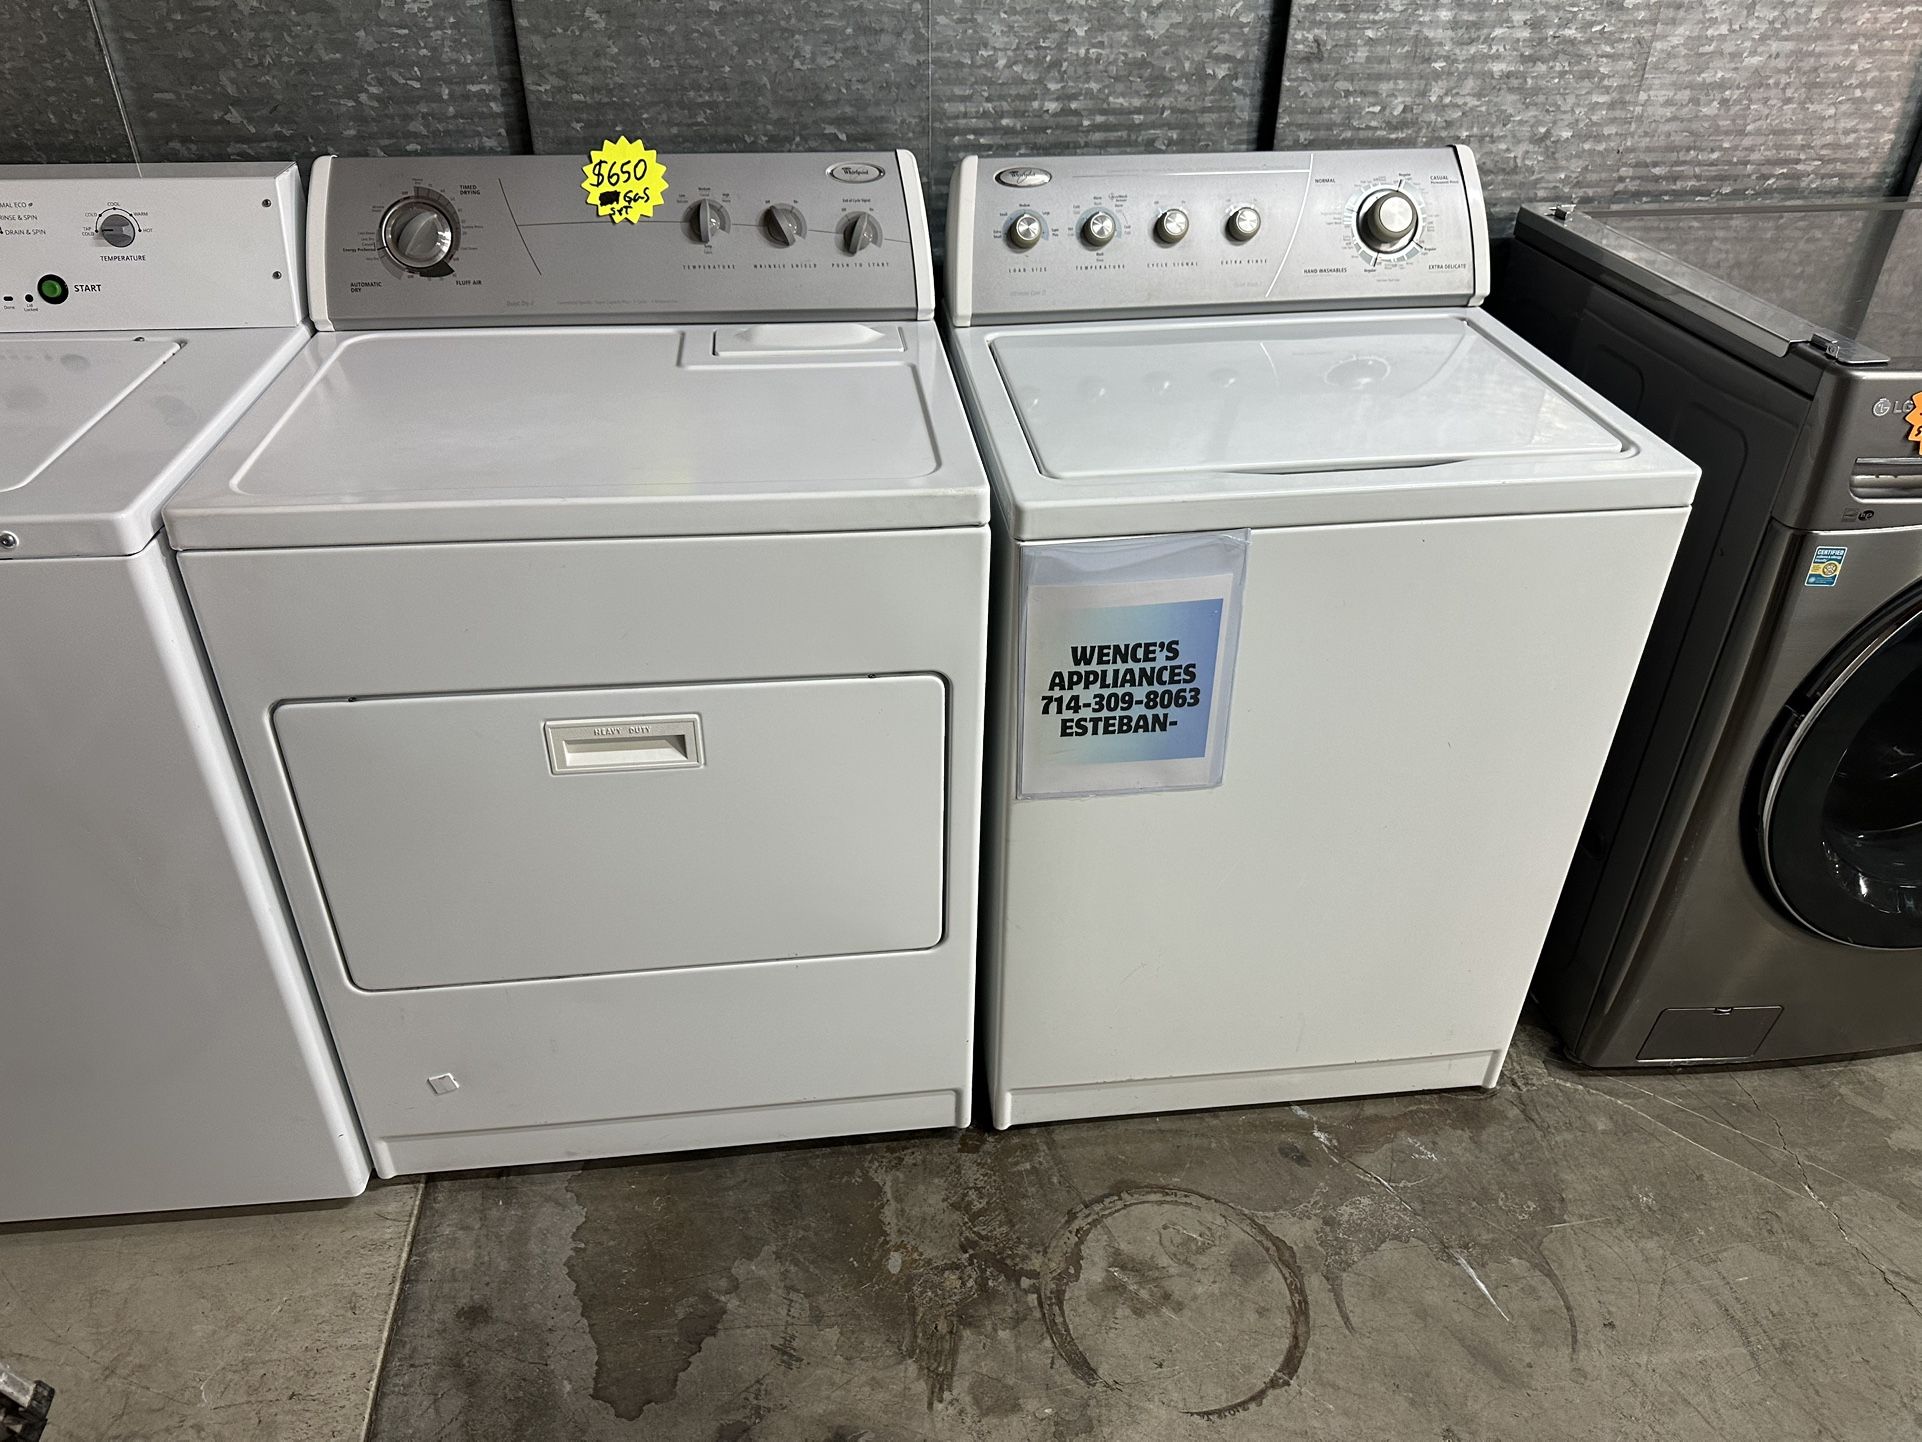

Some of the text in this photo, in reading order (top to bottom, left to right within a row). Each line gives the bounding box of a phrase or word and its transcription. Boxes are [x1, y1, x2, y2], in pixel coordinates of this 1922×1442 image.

[589, 159, 647, 188] $650
[74, 284, 101, 292] START
[1070, 640, 1180, 667] WENCE'S
[1048, 663, 1196, 692] APPLIANCES
[1041, 687, 1201, 715] 714-309-8063
[593, 726, 652, 736] HEAVY DUTY
[1059, 713, 1178, 738] ESTEBAN-
